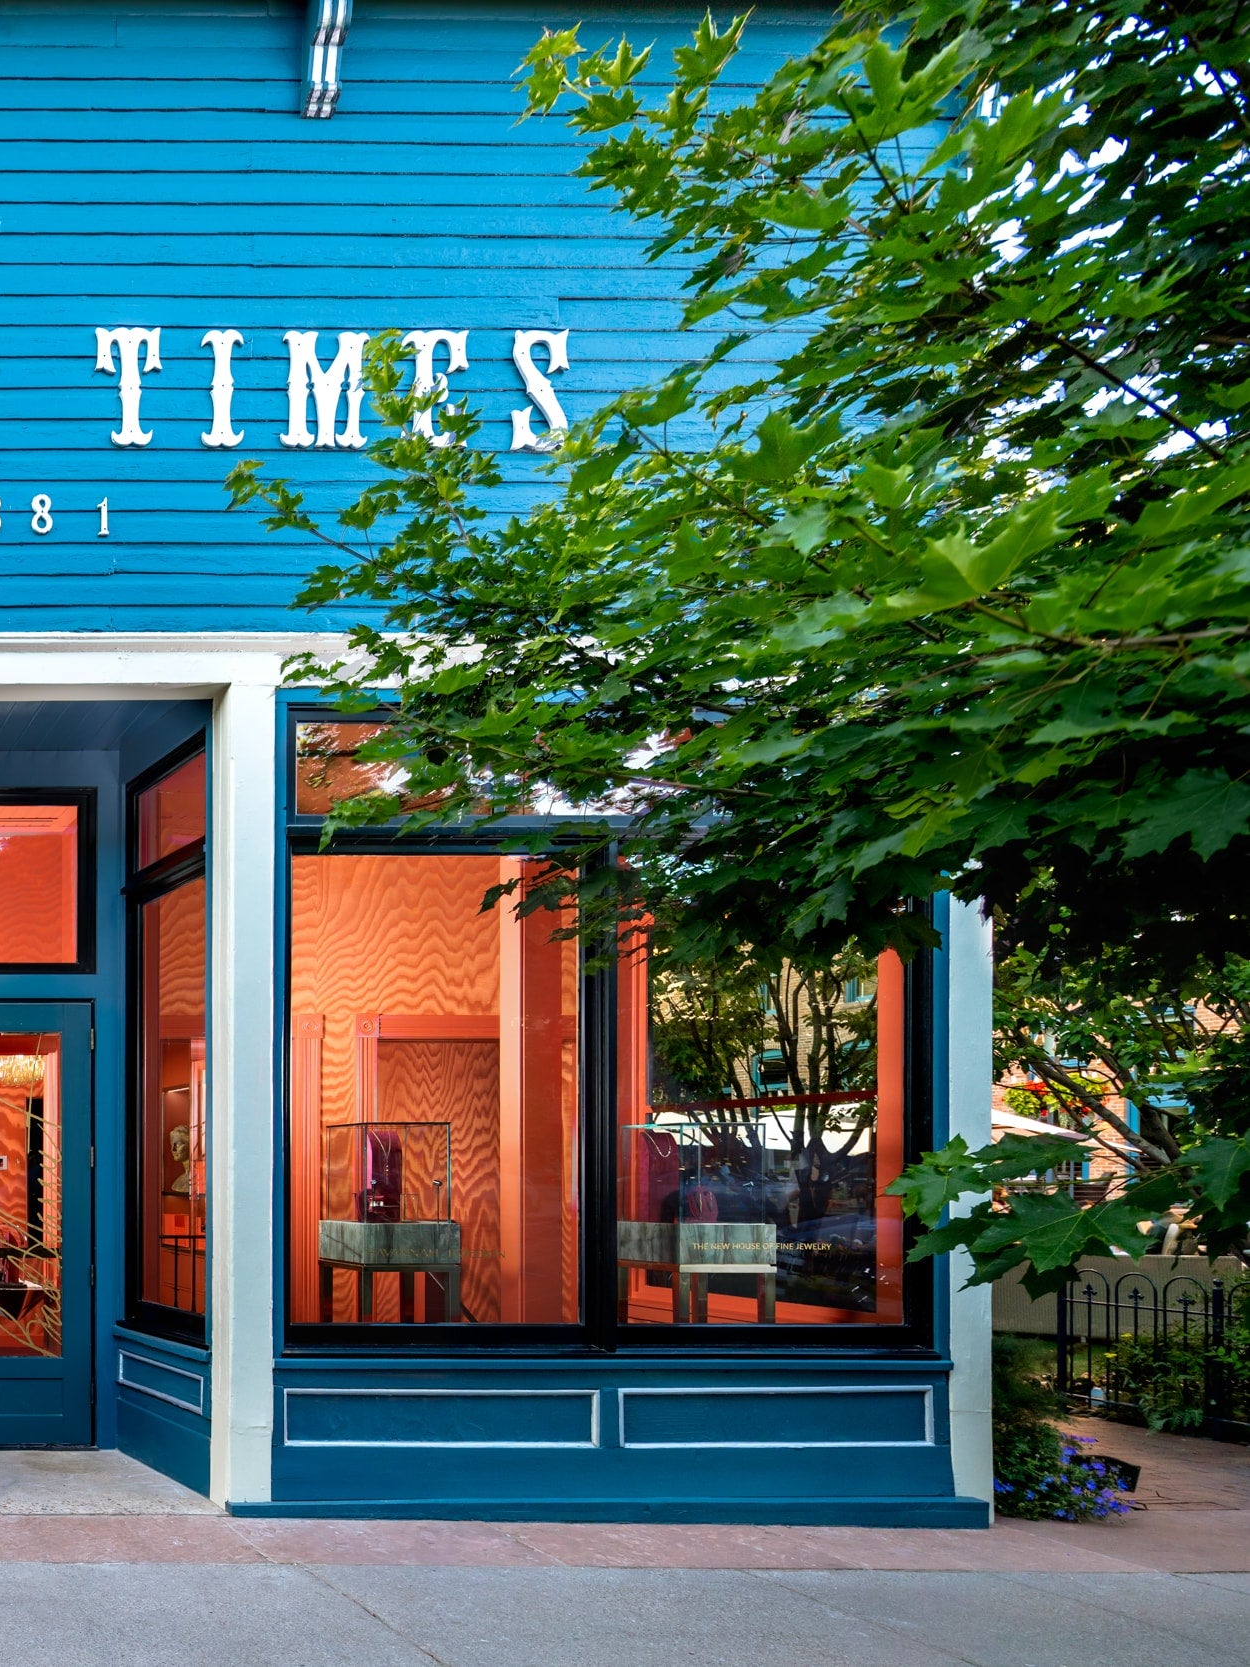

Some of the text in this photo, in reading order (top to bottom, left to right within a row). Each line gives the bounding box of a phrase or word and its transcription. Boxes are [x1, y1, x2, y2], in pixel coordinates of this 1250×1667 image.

[95, 327, 569, 452] TIMES
[776, 1243, 794, 1251] FINE
[796, 1243, 832, 1251] JEWELRY
